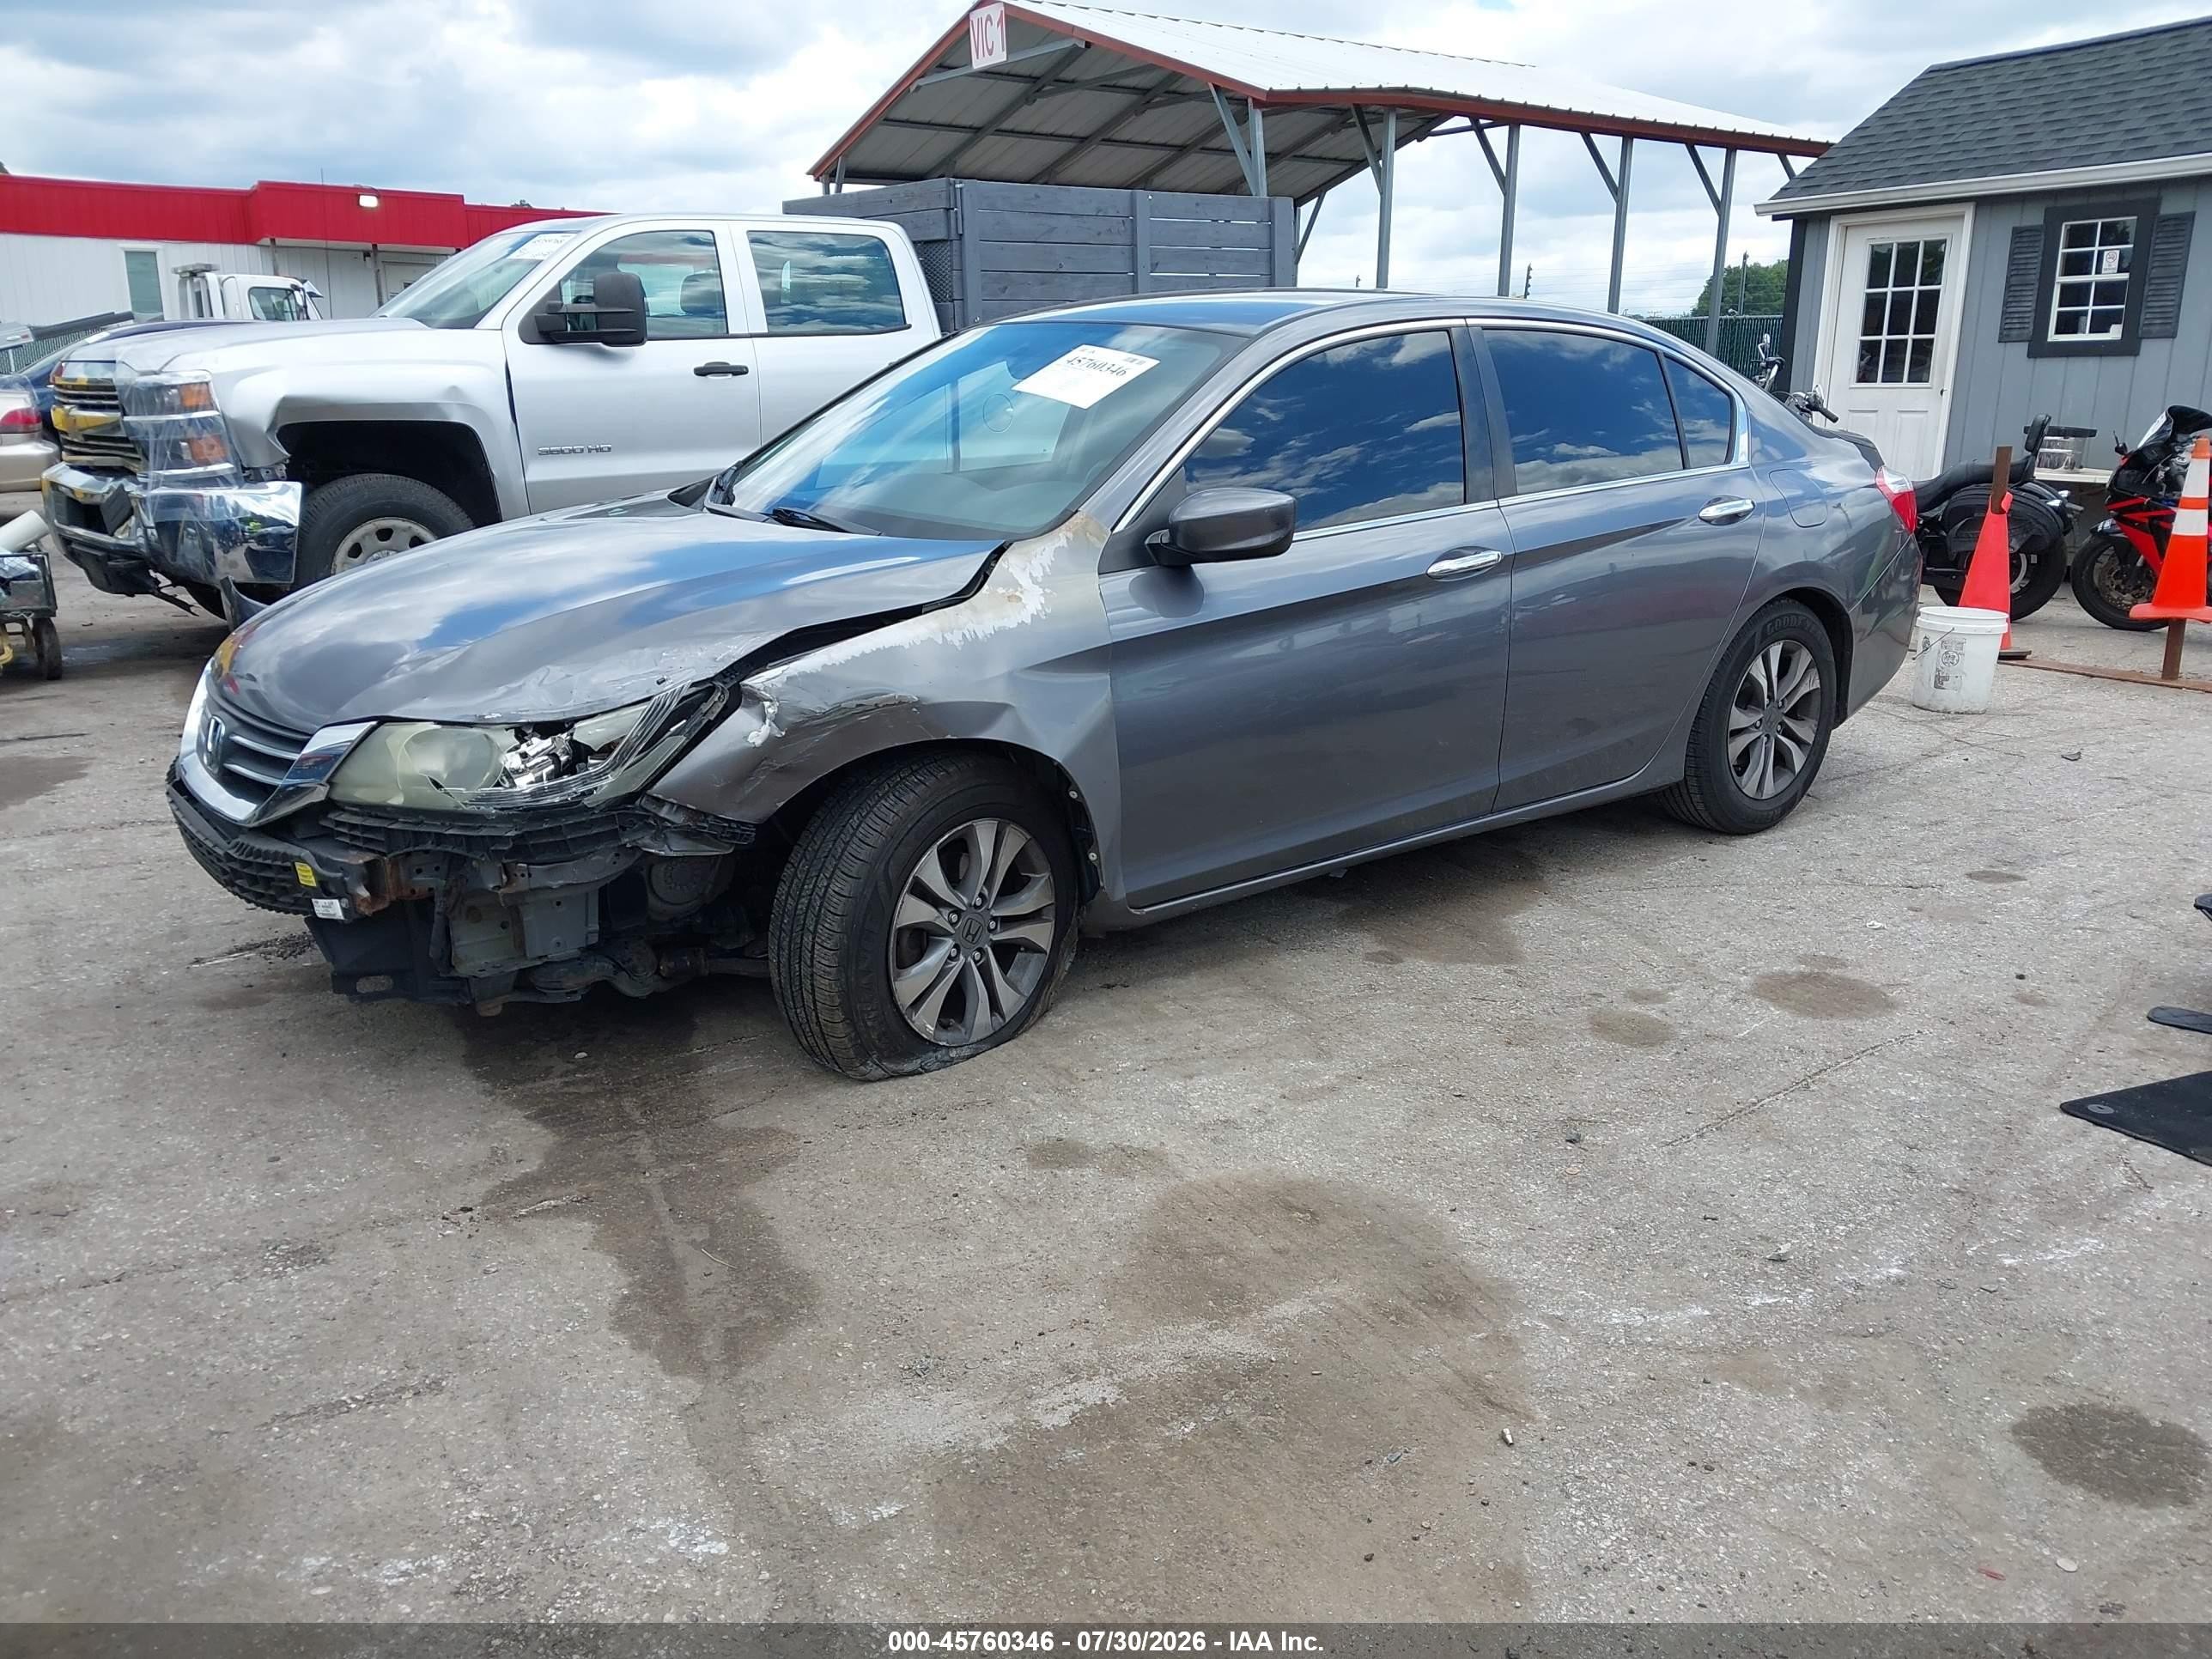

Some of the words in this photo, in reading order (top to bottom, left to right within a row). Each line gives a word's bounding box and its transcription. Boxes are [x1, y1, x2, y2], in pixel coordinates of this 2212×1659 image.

[970, 13, 994, 60] VIC
[997, 9, 1006, 52] 1
[1066, 356, 1127, 377] 45760346
[588, 444, 612, 454] HD
